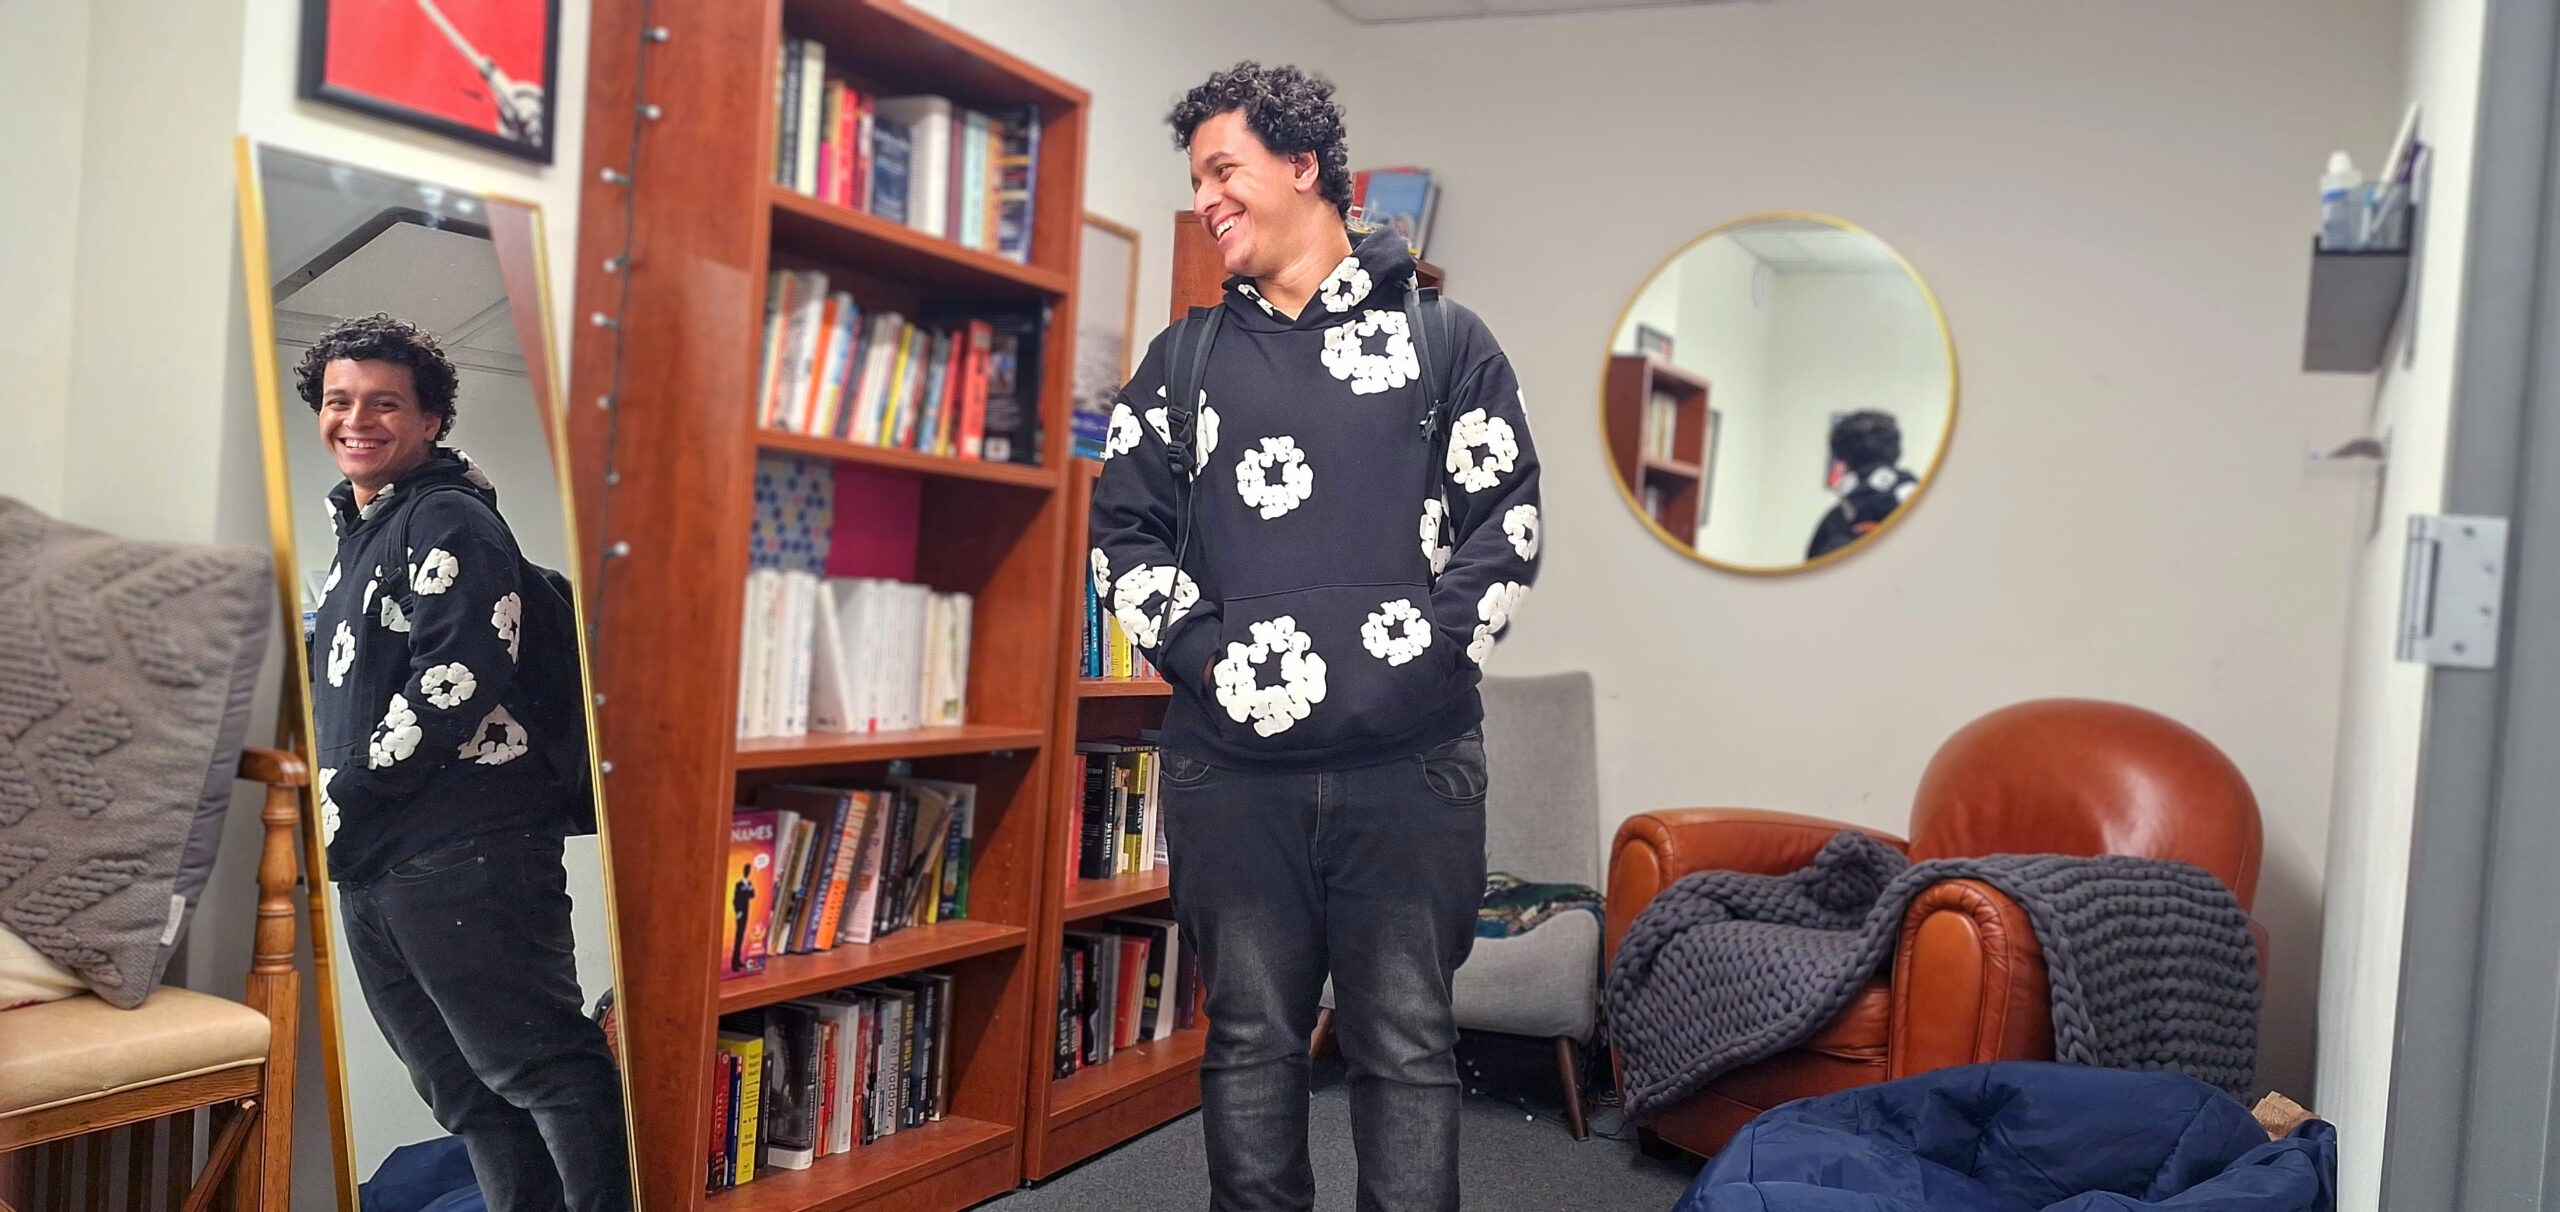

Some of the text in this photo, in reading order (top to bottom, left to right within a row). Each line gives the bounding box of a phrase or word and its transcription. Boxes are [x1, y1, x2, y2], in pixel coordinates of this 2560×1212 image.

[730, 824, 773, 843] NAMES
[832, 796, 870, 883] AIRFRAME
[905, 1004, 915, 1037] ADULT
[887, 1017, 901, 1119] Rachel Maddow
